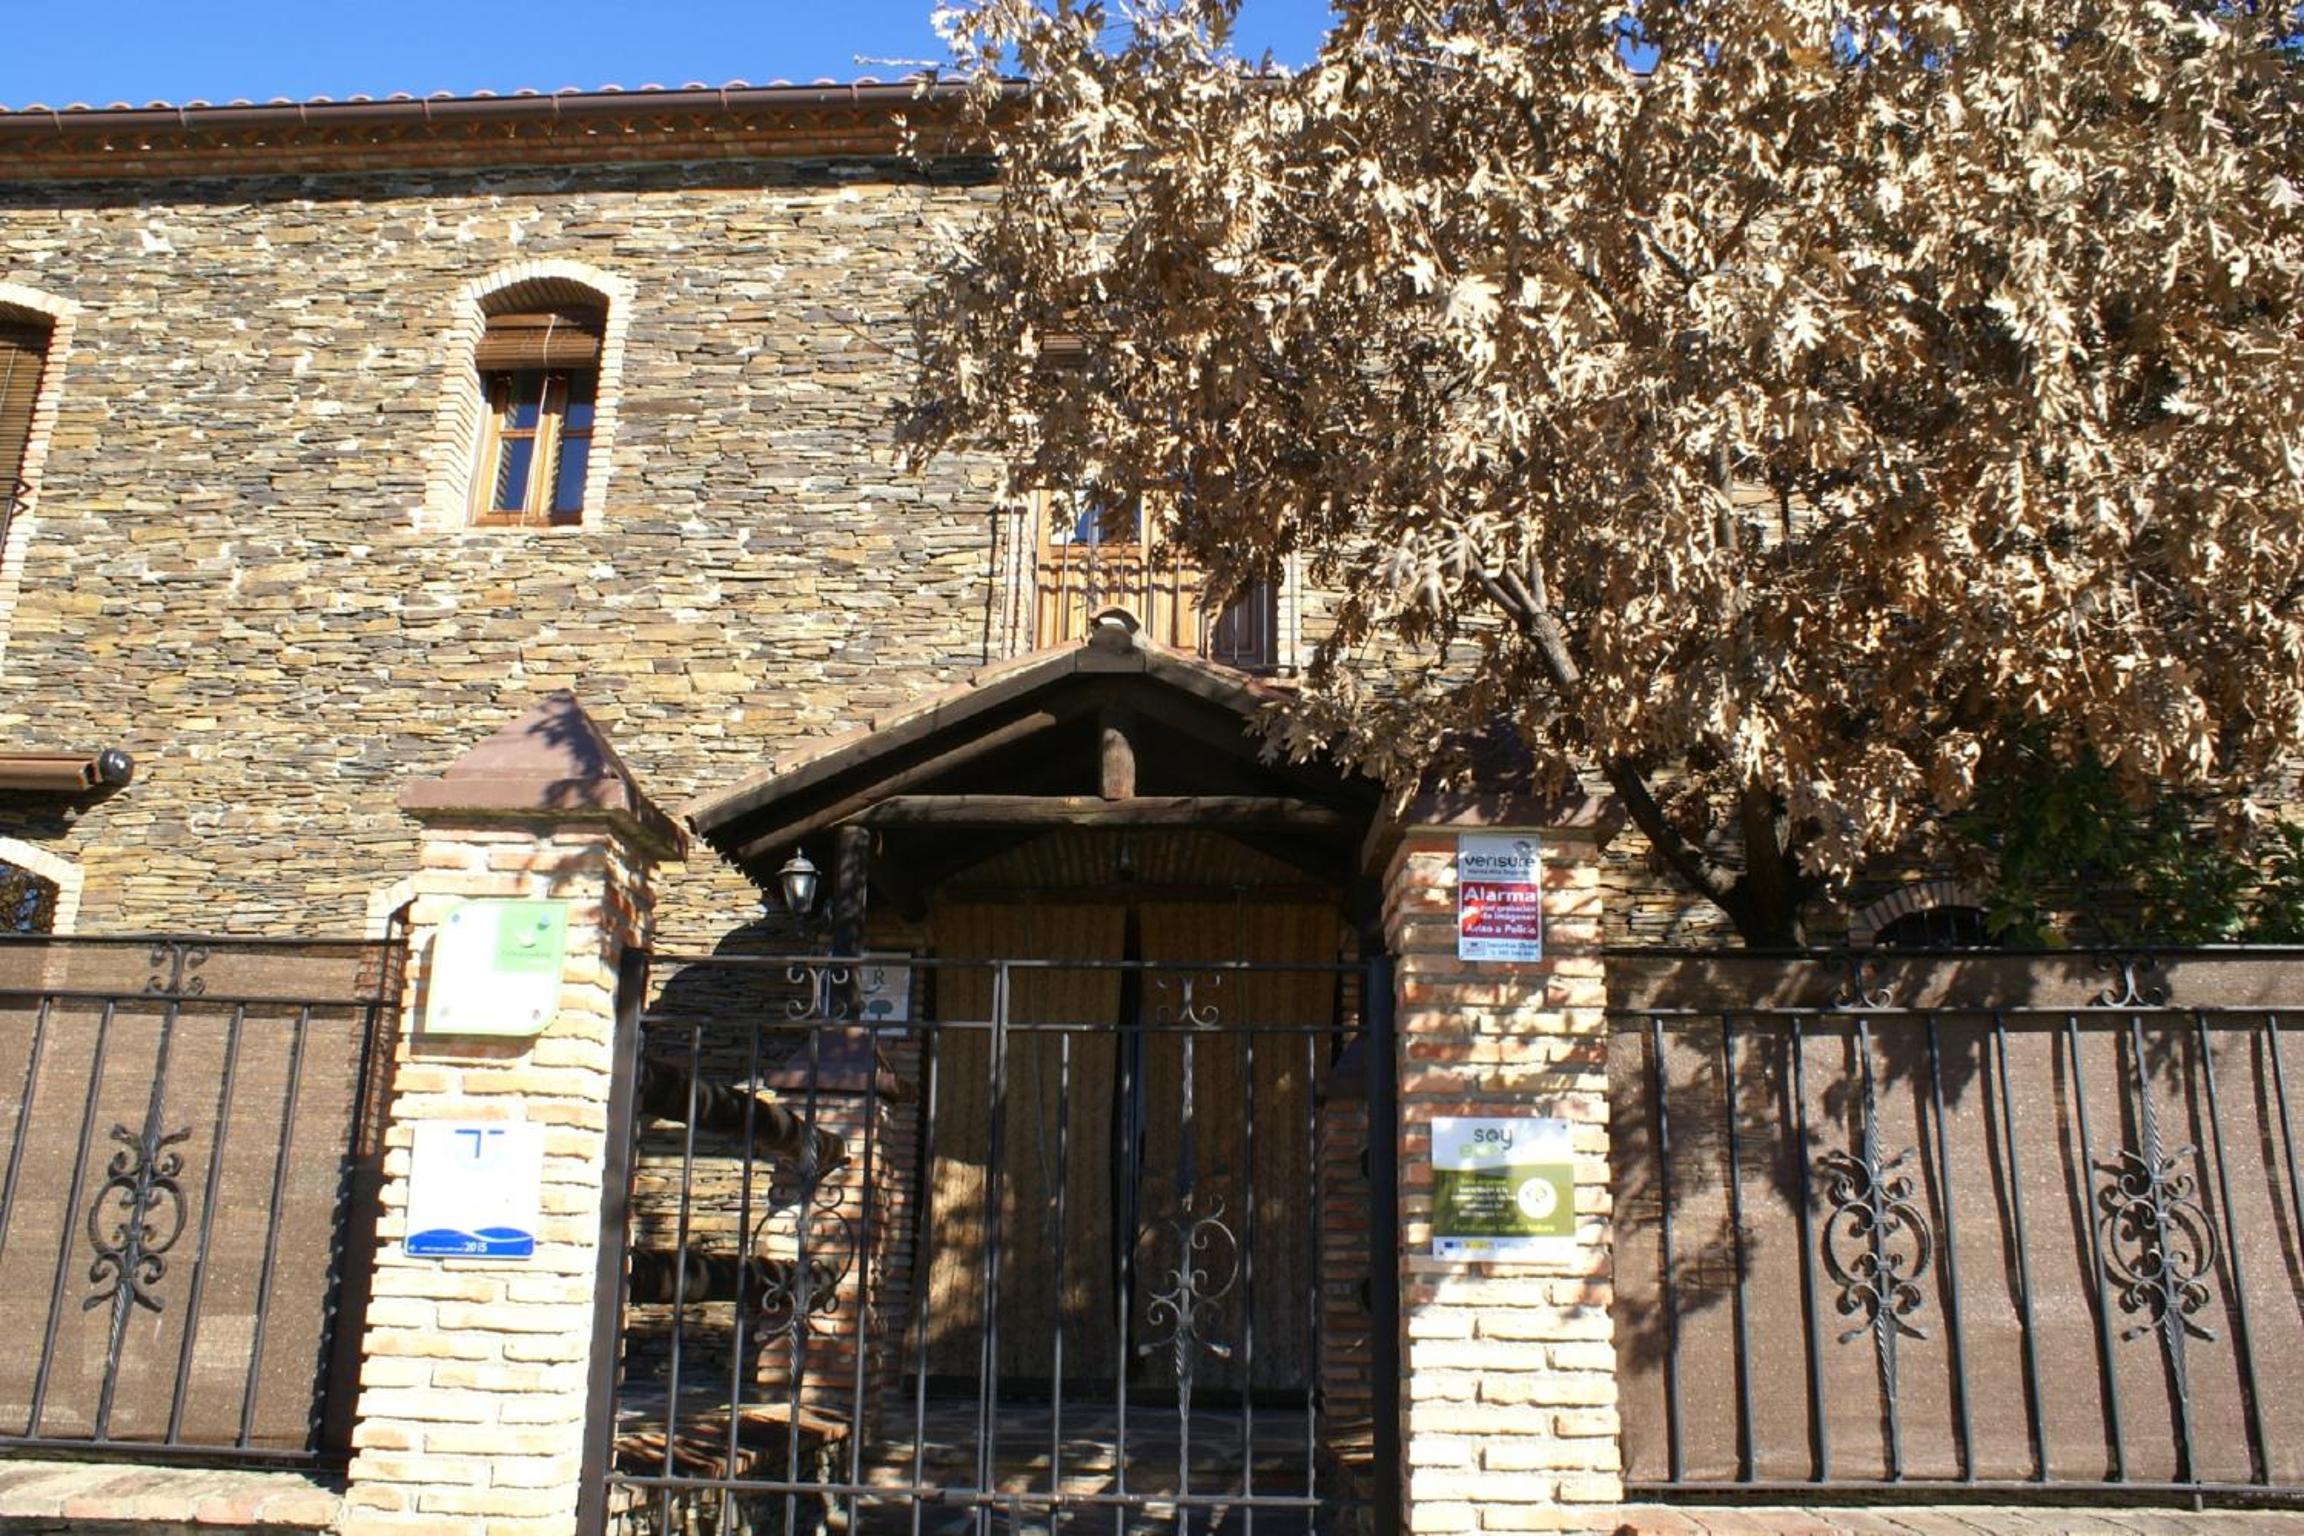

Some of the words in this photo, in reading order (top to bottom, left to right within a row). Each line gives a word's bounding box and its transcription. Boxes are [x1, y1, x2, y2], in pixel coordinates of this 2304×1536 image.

[1464, 887, 1536, 901] Alarma
[1473, 1128, 1513, 1150] soy
[464, 1240, 488, 1253] 2015
